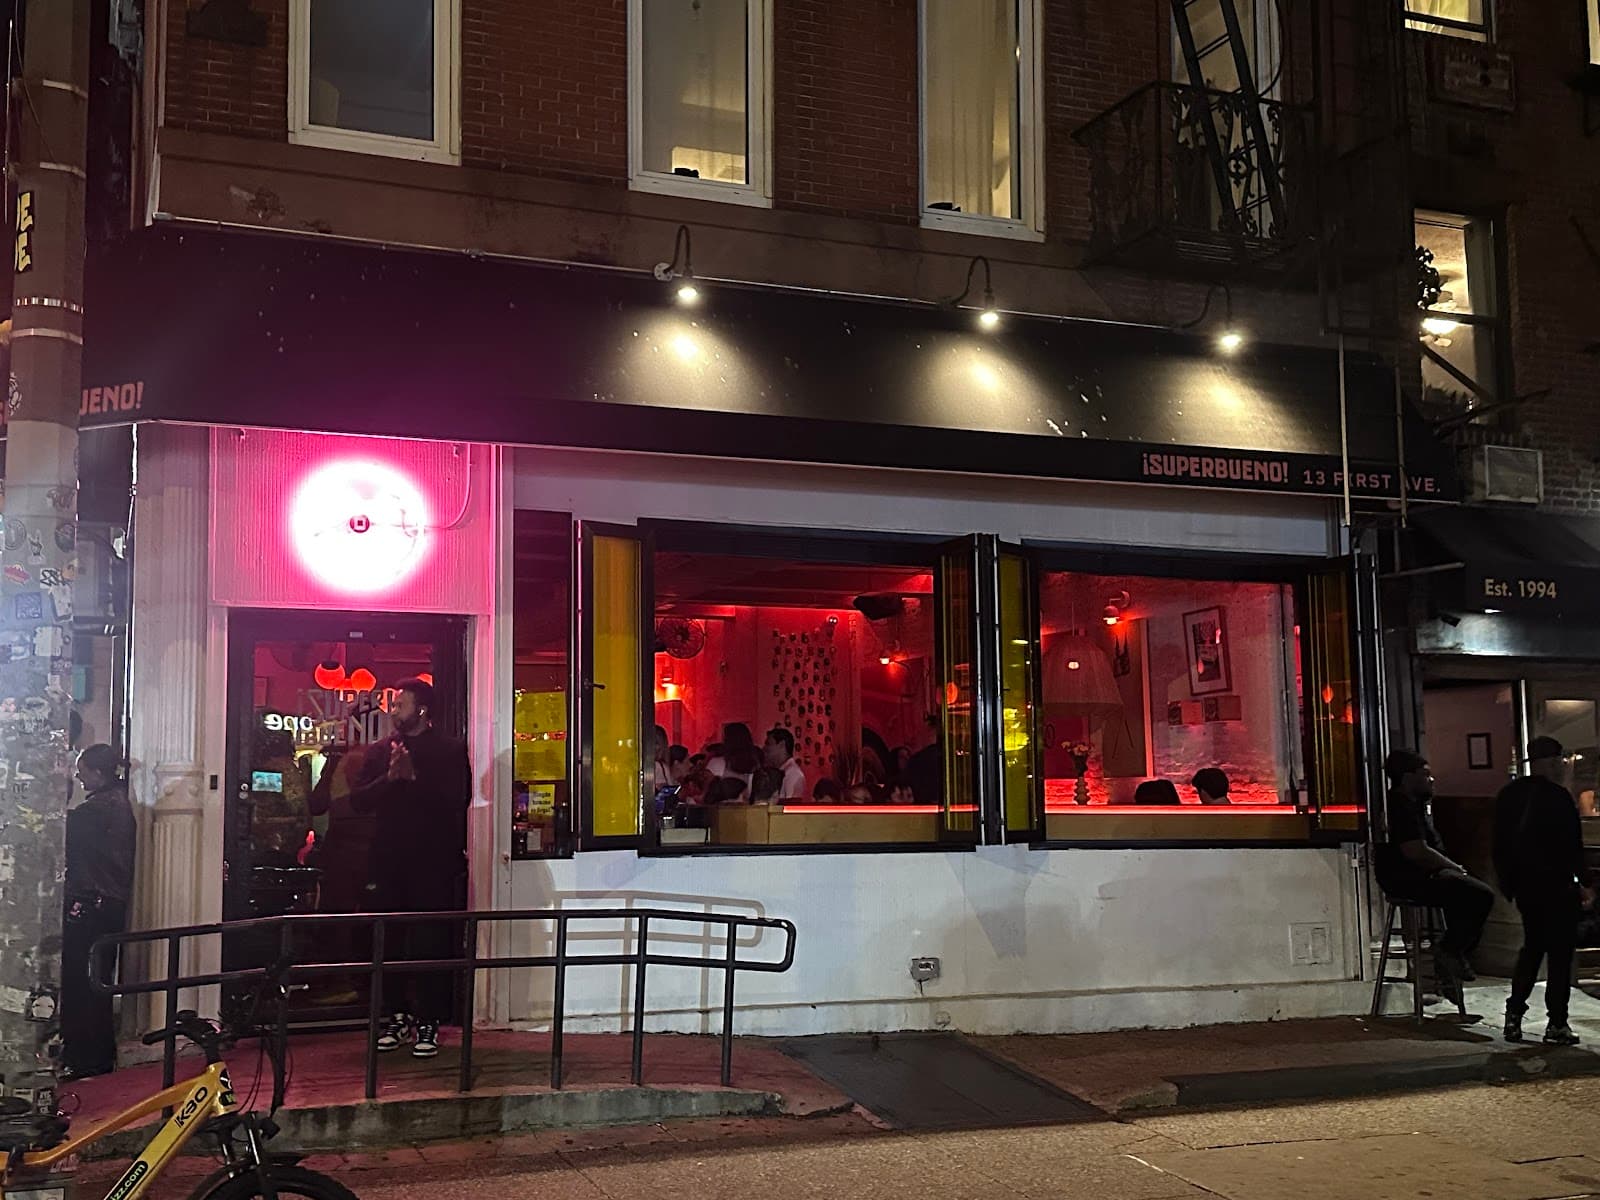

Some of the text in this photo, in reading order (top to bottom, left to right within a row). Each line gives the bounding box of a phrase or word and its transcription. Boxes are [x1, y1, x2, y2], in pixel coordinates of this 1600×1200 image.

[1143, 453, 1288, 483] ¡SUPERBUENO!
[1303, 470, 1326, 486] 13
[1485, 578, 1557, 599] Est. 1994
